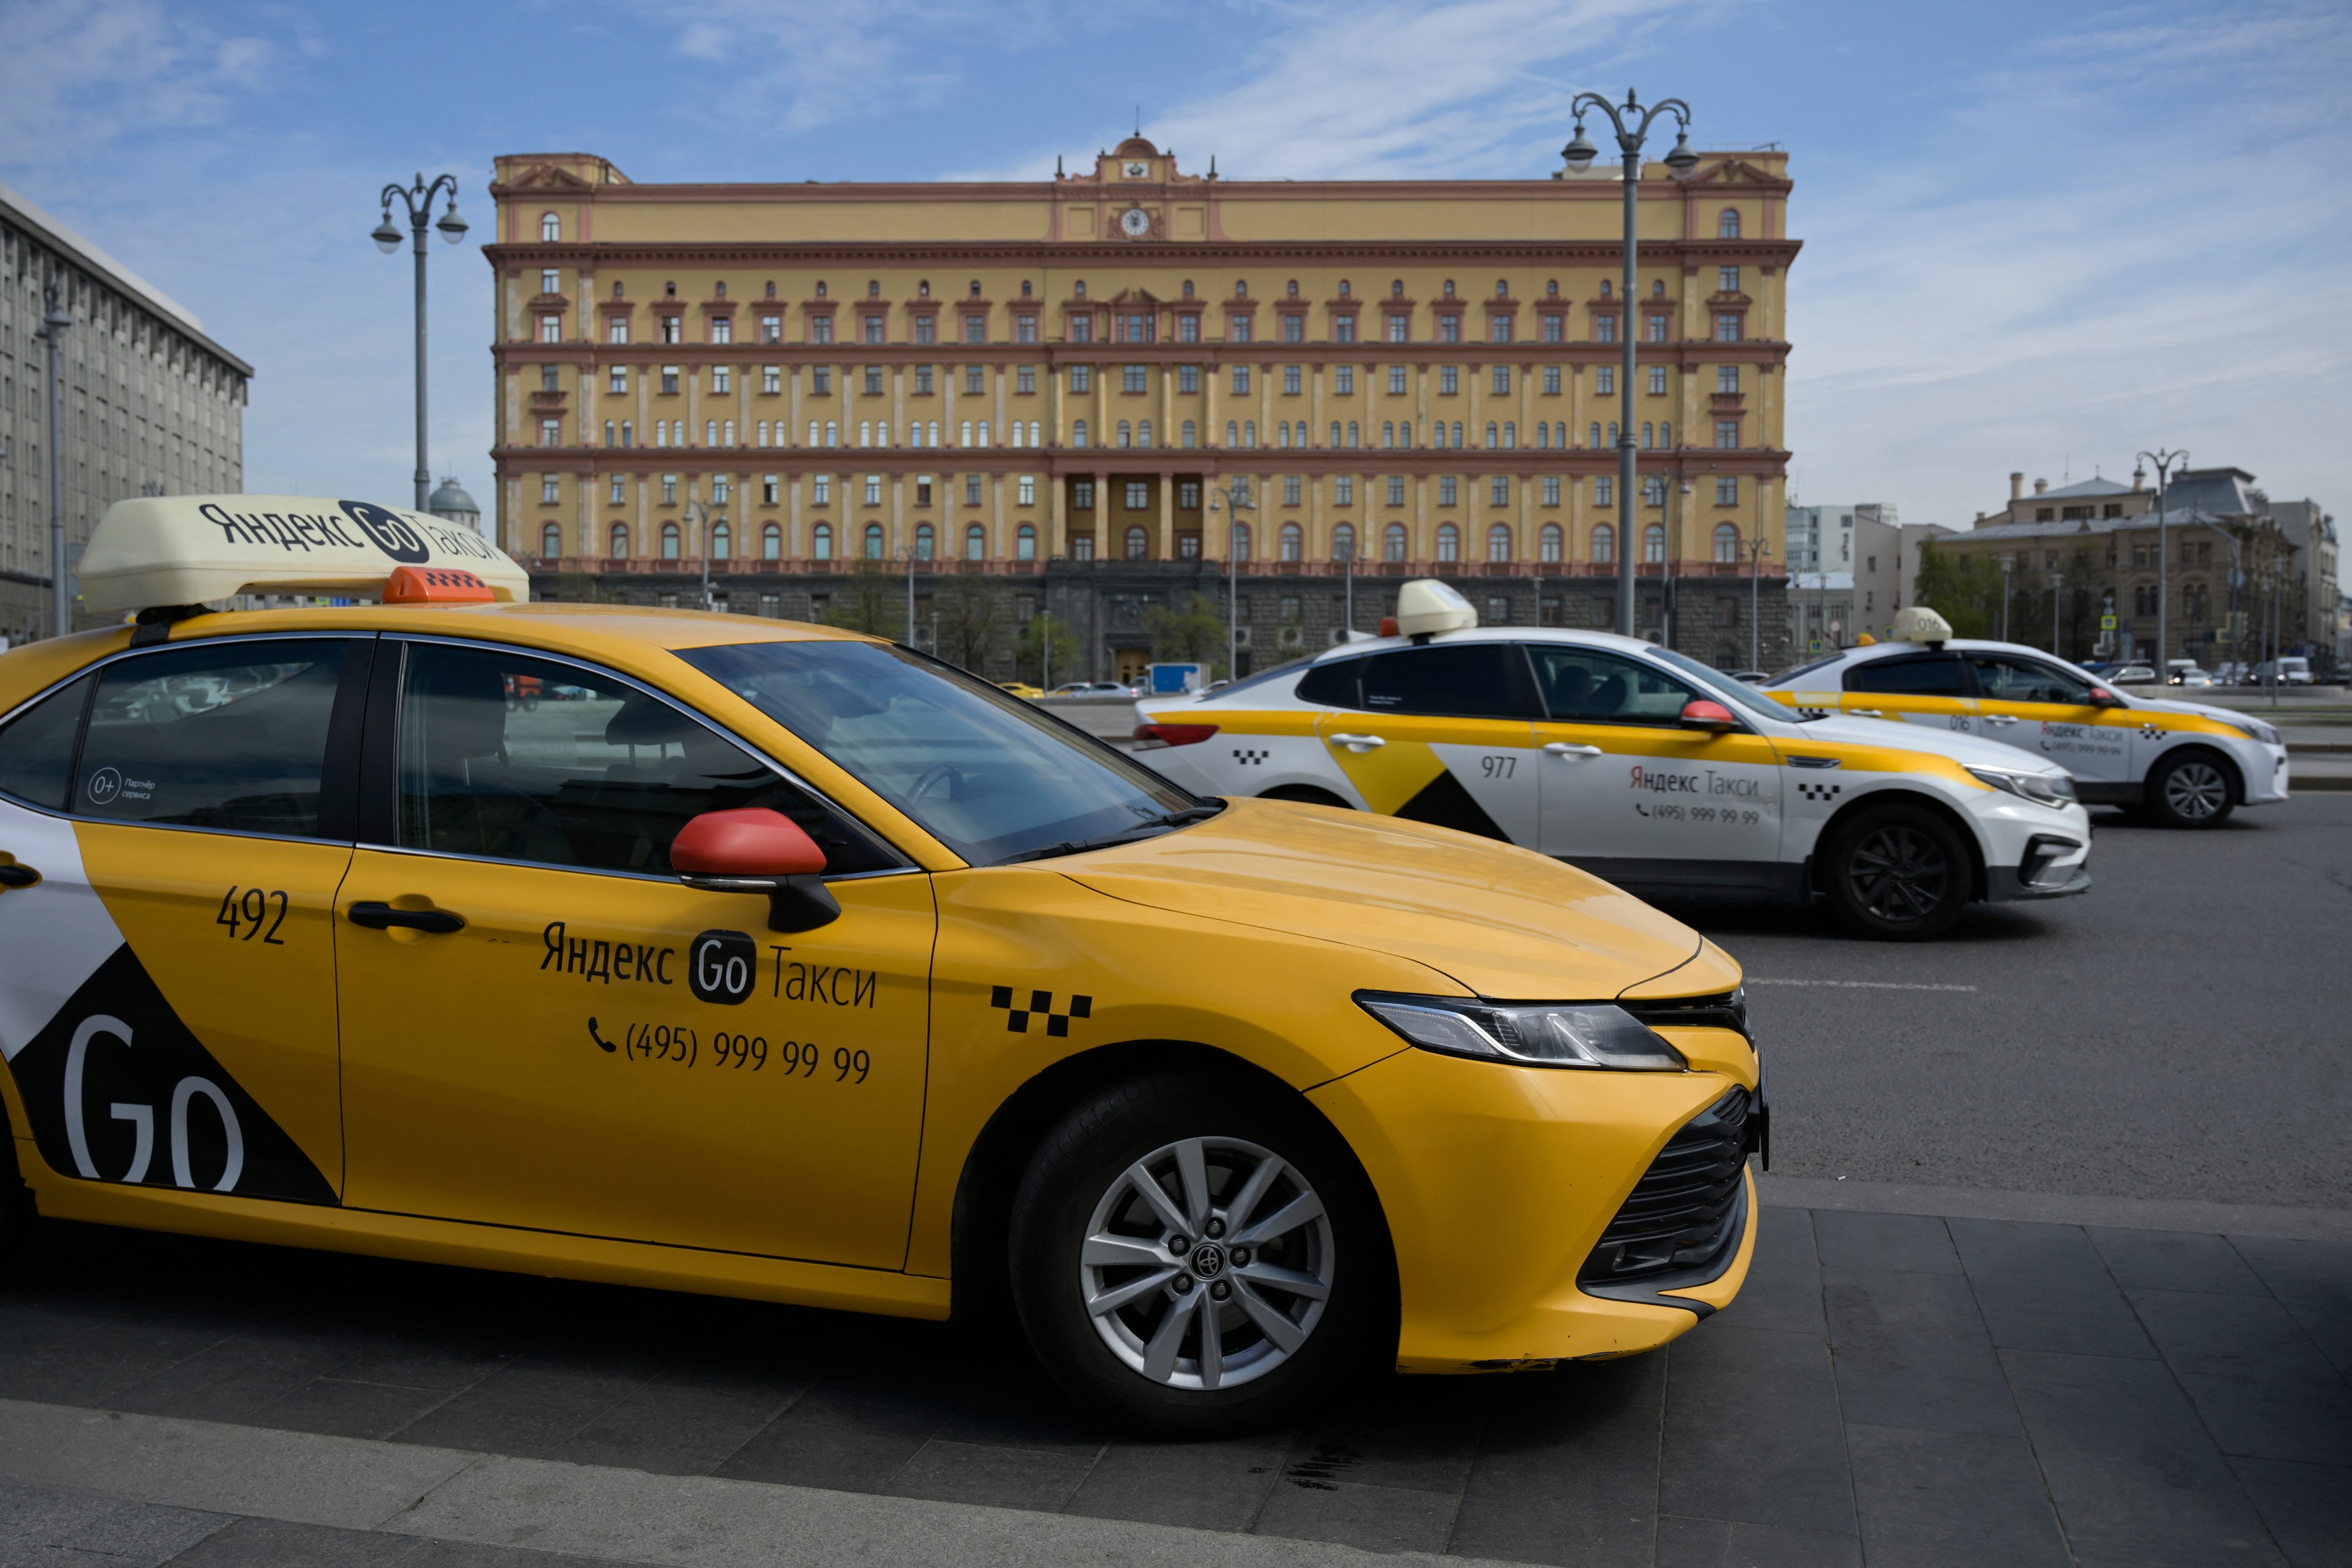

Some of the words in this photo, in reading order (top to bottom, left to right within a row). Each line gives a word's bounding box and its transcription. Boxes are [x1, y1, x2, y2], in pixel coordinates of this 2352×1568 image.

[199, 504, 363, 551] Яндекс
[353, 507, 422, 553] Go
[402, 516, 501, 561] Такси
[2041, 721, 2083, 738] Яндекс
[1482, 756, 1517, 779] 977
[95, 776, 115, 793] 0+
[125, 778, 156, 790] Партнёр
[1630, 766, 1699, 793] Яндекс
[1705, 771, 1759, 797] Такси
[121, 791, 151, 800] сервиса
[1652, 805, 1685, 821] (495)
[1691, 807, 1716, 822] 999
[1720, 809, 1738, 823] 99
[1742, 810, 1759, 824] 99
[216, 886, 288, 945] 492
[540, 921, 675, 985] Яндекс
[697, 939, 748, 995] Go
[769, 945, 877, 1009] Такси
[626, 1023, 697, 1068] (495)
[713, 1032, 768, 1071] 999
[782, 1041, 819, 1078] 99
[833, 1047, 871, 1084] 99
[64, 1014, 244, 1192] Go
